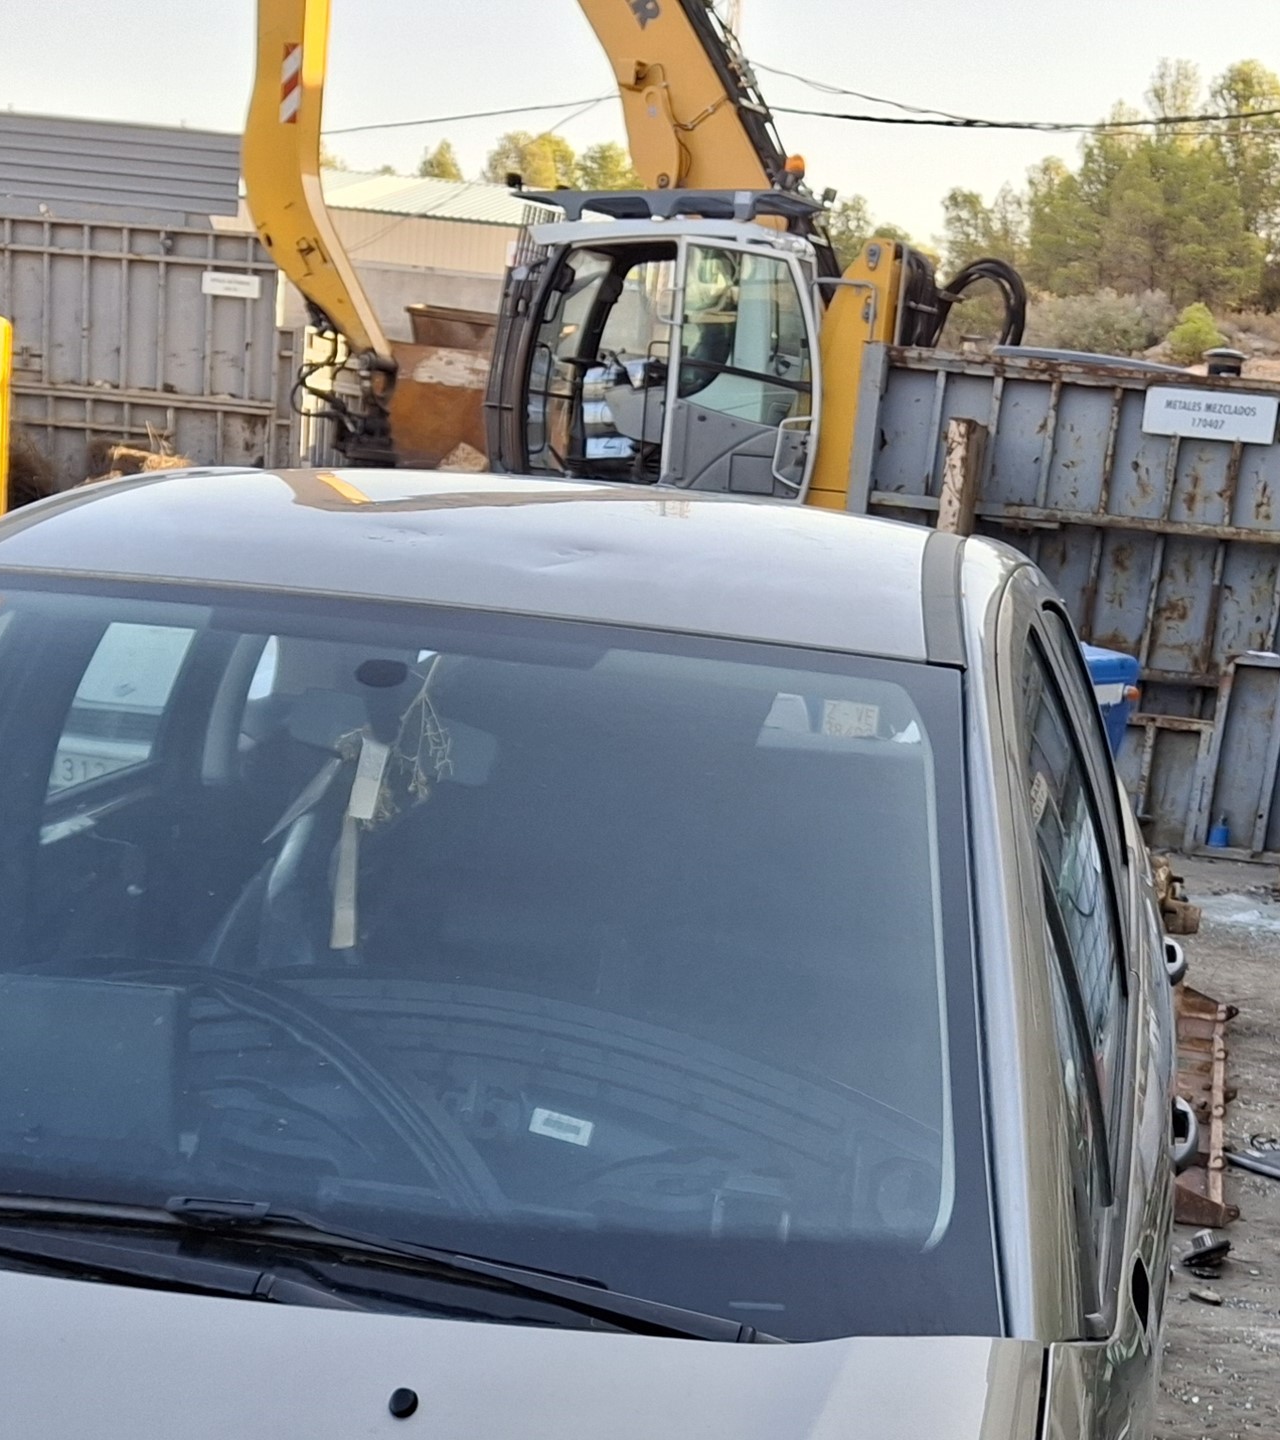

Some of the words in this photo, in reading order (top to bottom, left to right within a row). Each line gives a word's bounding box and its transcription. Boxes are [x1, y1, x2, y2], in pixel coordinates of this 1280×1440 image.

[1164, 399, 1202, 412] METALES
[1204, 402, 1257, 417] MEZCLADOS
[1191, 417, 1225, 430] 170407
